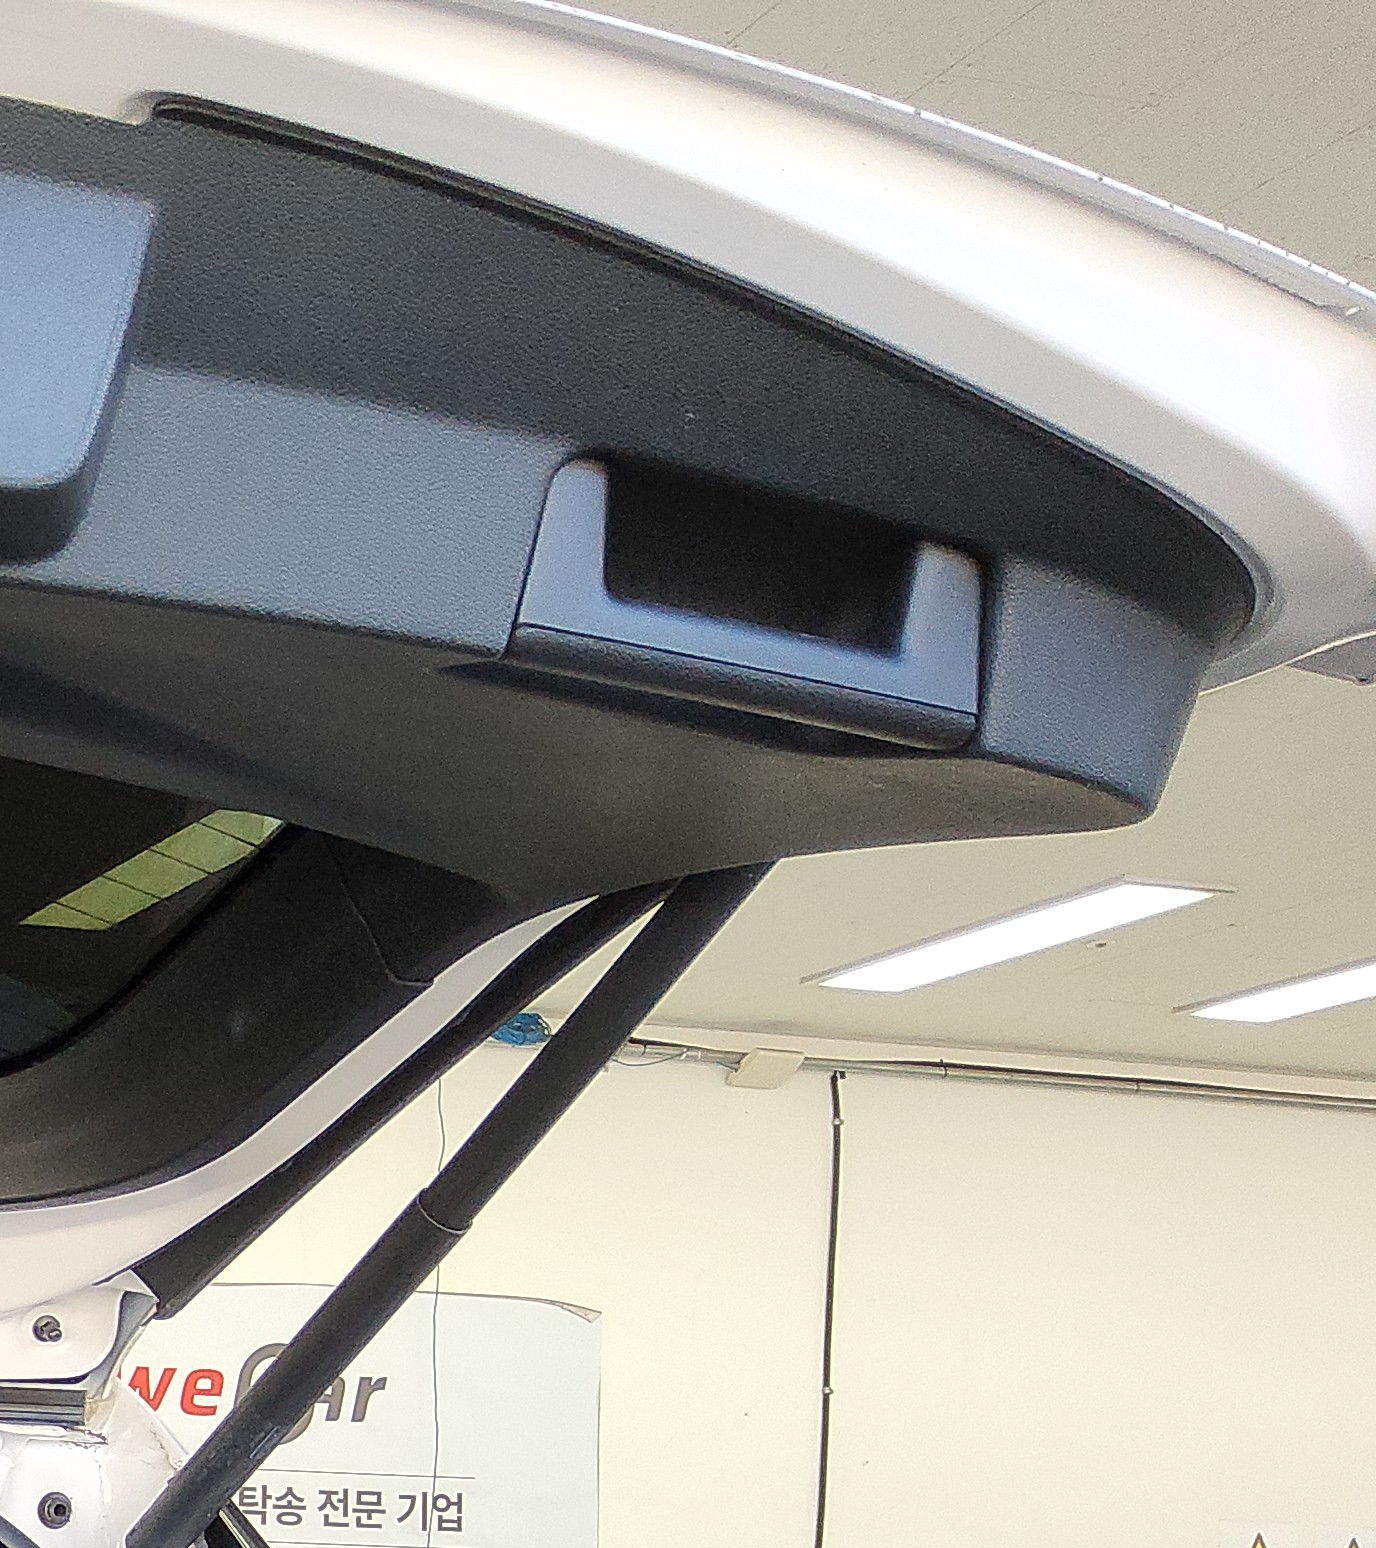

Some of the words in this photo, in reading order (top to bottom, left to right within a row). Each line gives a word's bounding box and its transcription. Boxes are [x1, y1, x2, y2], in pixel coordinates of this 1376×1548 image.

[238, 1484, 307, 1526] 탁송
[317, 1488, 387, 1529] 전문
[396, 1491, 464, 1532] 기업
